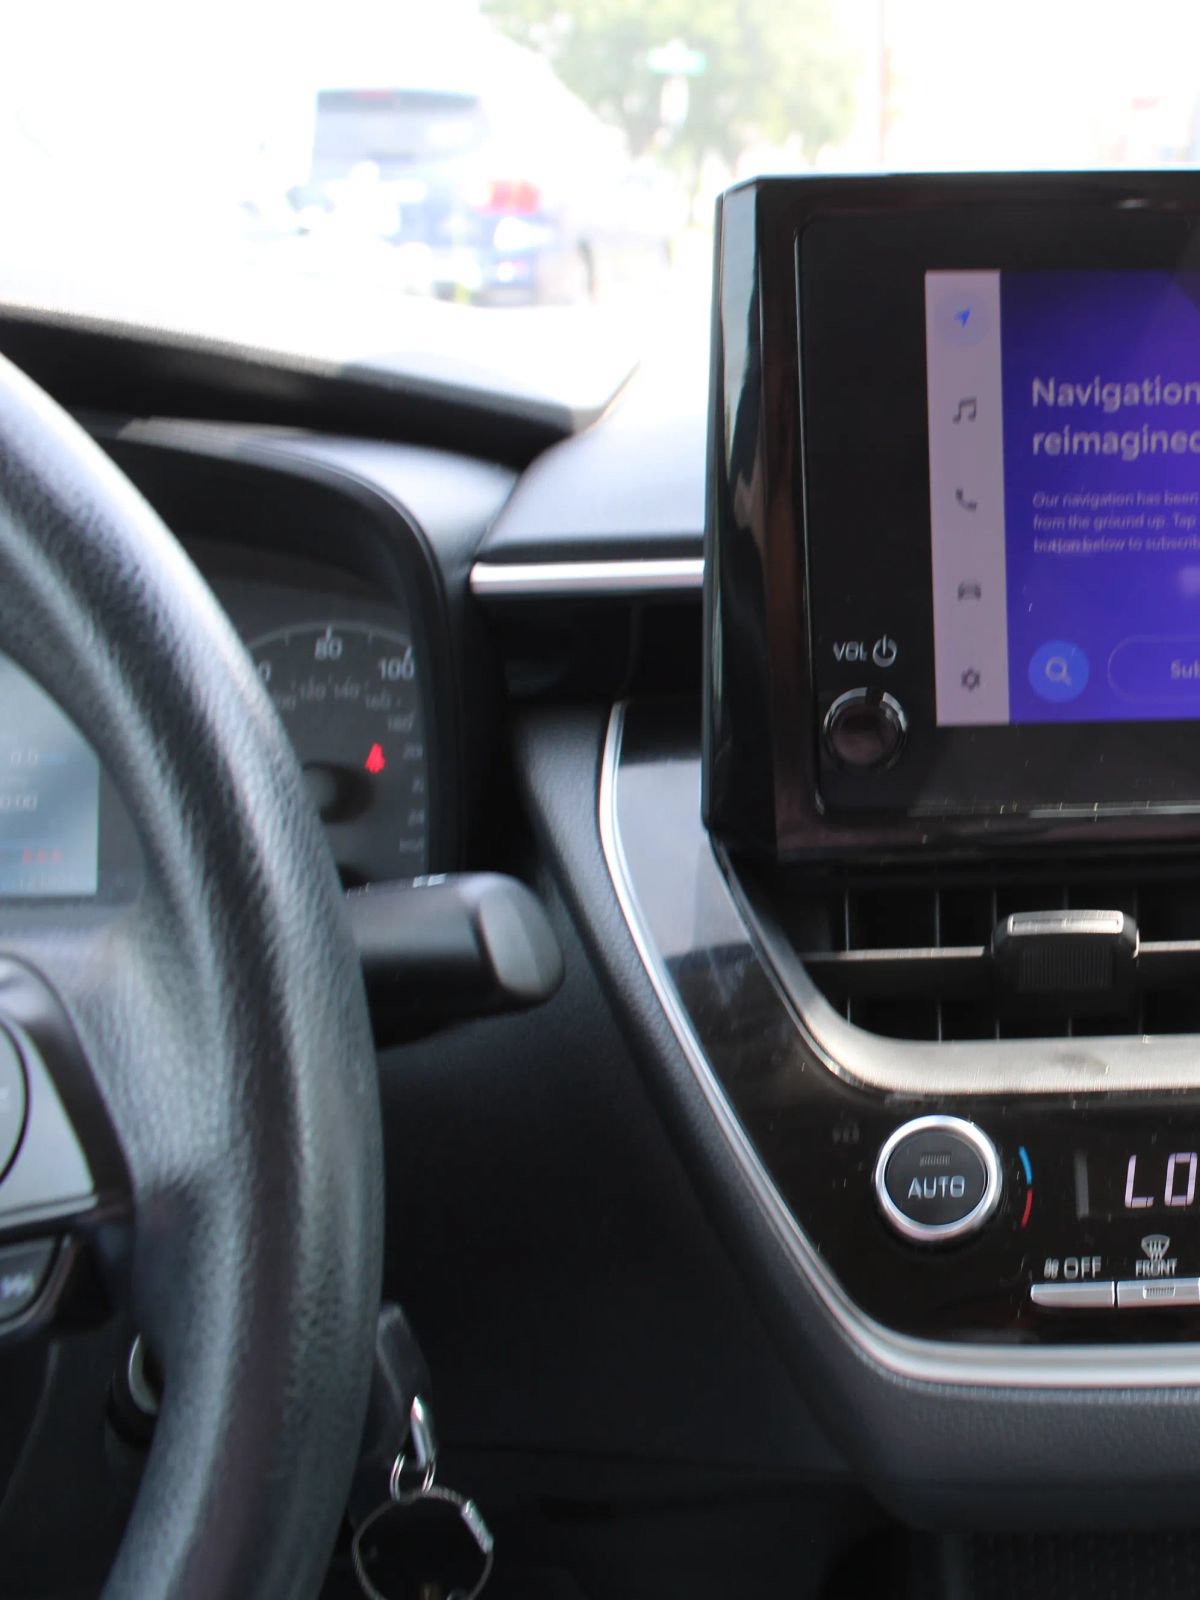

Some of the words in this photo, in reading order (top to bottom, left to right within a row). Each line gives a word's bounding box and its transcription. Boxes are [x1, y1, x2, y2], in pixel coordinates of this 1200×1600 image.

[1032, 491, 1059, 508] Our
[1062, 489, 1134, 510] navigation
[1137, 489, 1160, 506] has
[1164, 489, 1199, 506] been
[1033, 514, 1065, 530] from
[1068, 513, 1090, 530] the
[1094, 513, 1145, 531] ground
[1173, 513, 1197, 531] Tap
[1128, 536, 1144, 551] to
[314, 637, 343, 660] 80
[832, 640, 868, 662] VOL
[378, 657, 415, 681] 100
[907, 1175, 966, 1199] AUTO
[1125, 1151, 1198, 1208] LO
[1063, 1256, 1102, 1280] OFF
[1135, 1257, 1179, 1278] FRONT
